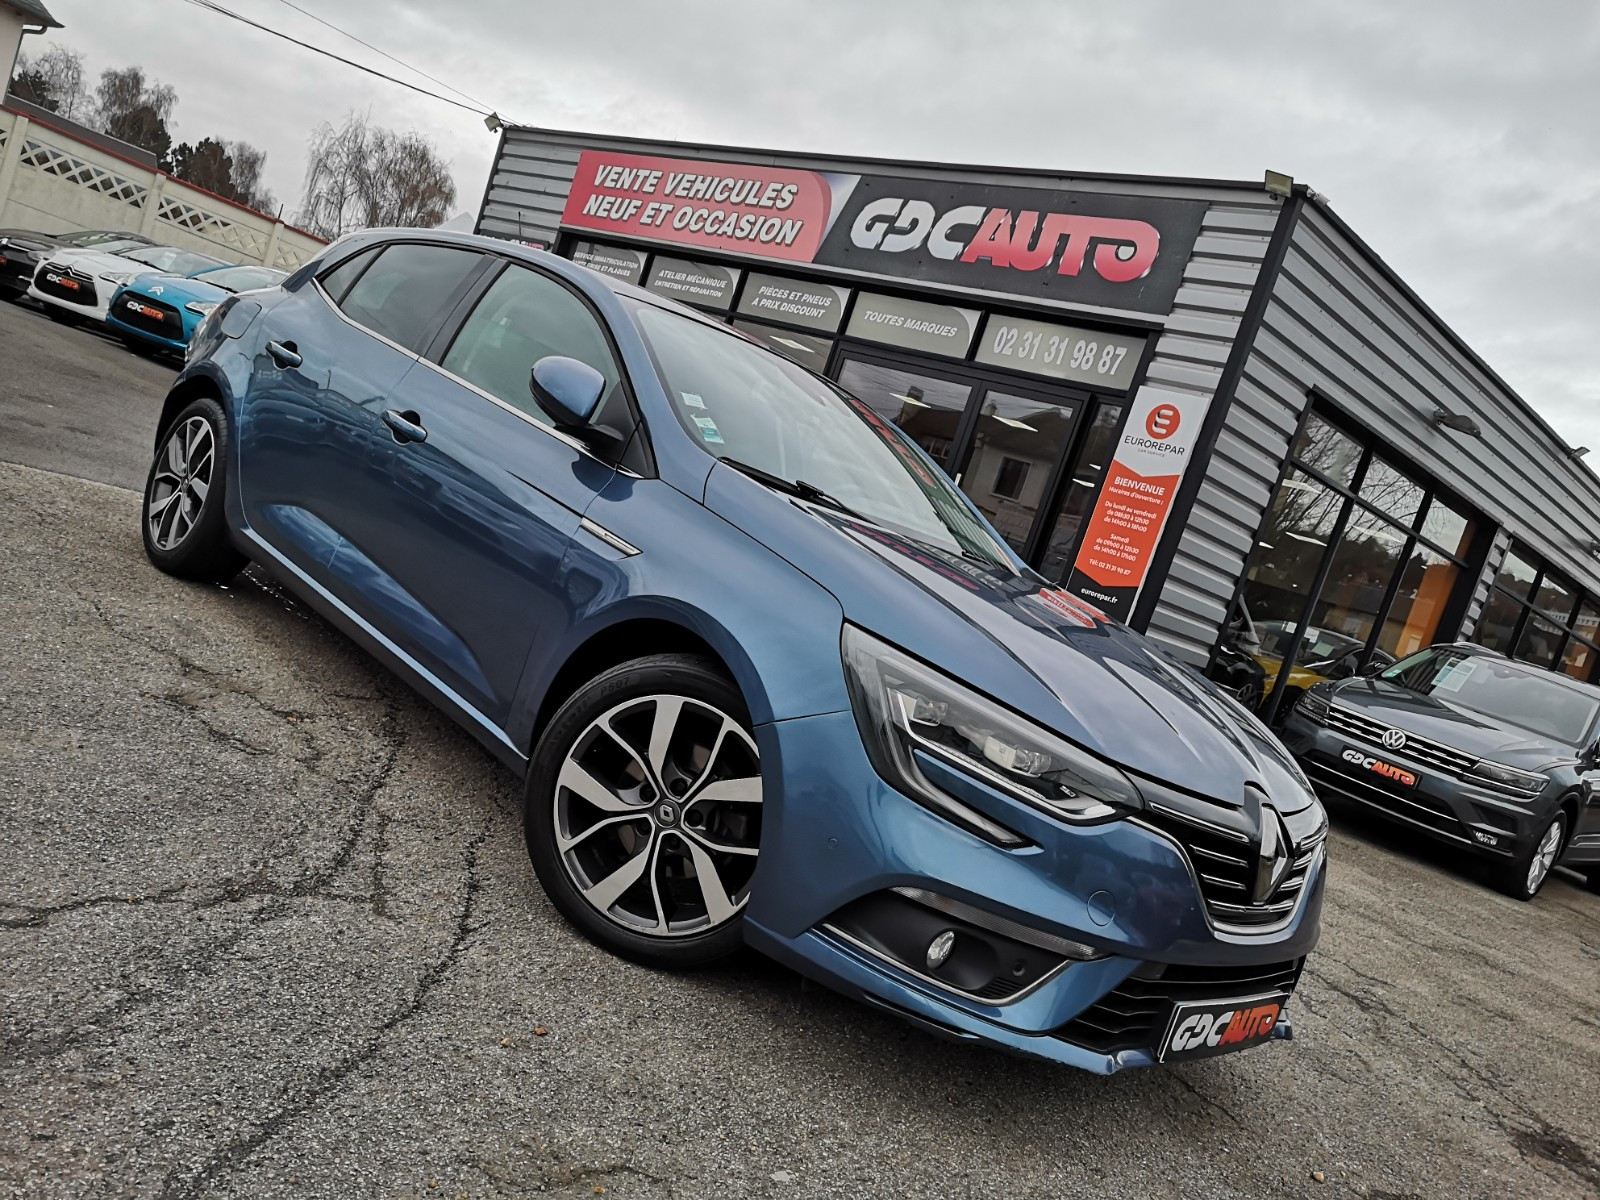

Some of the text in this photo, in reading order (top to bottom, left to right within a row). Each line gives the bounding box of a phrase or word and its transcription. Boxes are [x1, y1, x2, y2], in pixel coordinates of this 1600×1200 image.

[593, 164, 798, 210] VENTE VEHICULES
[582, 194, 803, 247] NEUF ET OCCASION
[573, 251, 639, 269] SERVICE IMMATRICULATION
[607, 266, 631, 277] PLAQUES
[659, 270, 728, 288] ATELIER MÉCANIQUE
[654, 280, 682, 290] ENTRETIEN
[689, 285, 723, 297] RÉPARATION
[758, 285, 833, 307] PIÈCES ET PNEUS
[751, 297, 826, 318] A PRIX DISCOUNT
[864, 310, 958, 338] TOUTES MARQUES
[993, 326, 1128, 376] 02 31 31 98 87
[1124, 435, 1185, 456] EUROREPAR
[1108, 486, 1130, 497] Horaires
[1130, 492, 1161, 505] d'ouverture
[1114, 476, 1165, 496] BIENVENUE
[1113, 502, 1126, 511] lundi
[1133, 509, 1157, 519] vendredi
[1110, 533, 1130, 544] Samedi
[1081, 587, 1118, 604] eurorepar.fr
